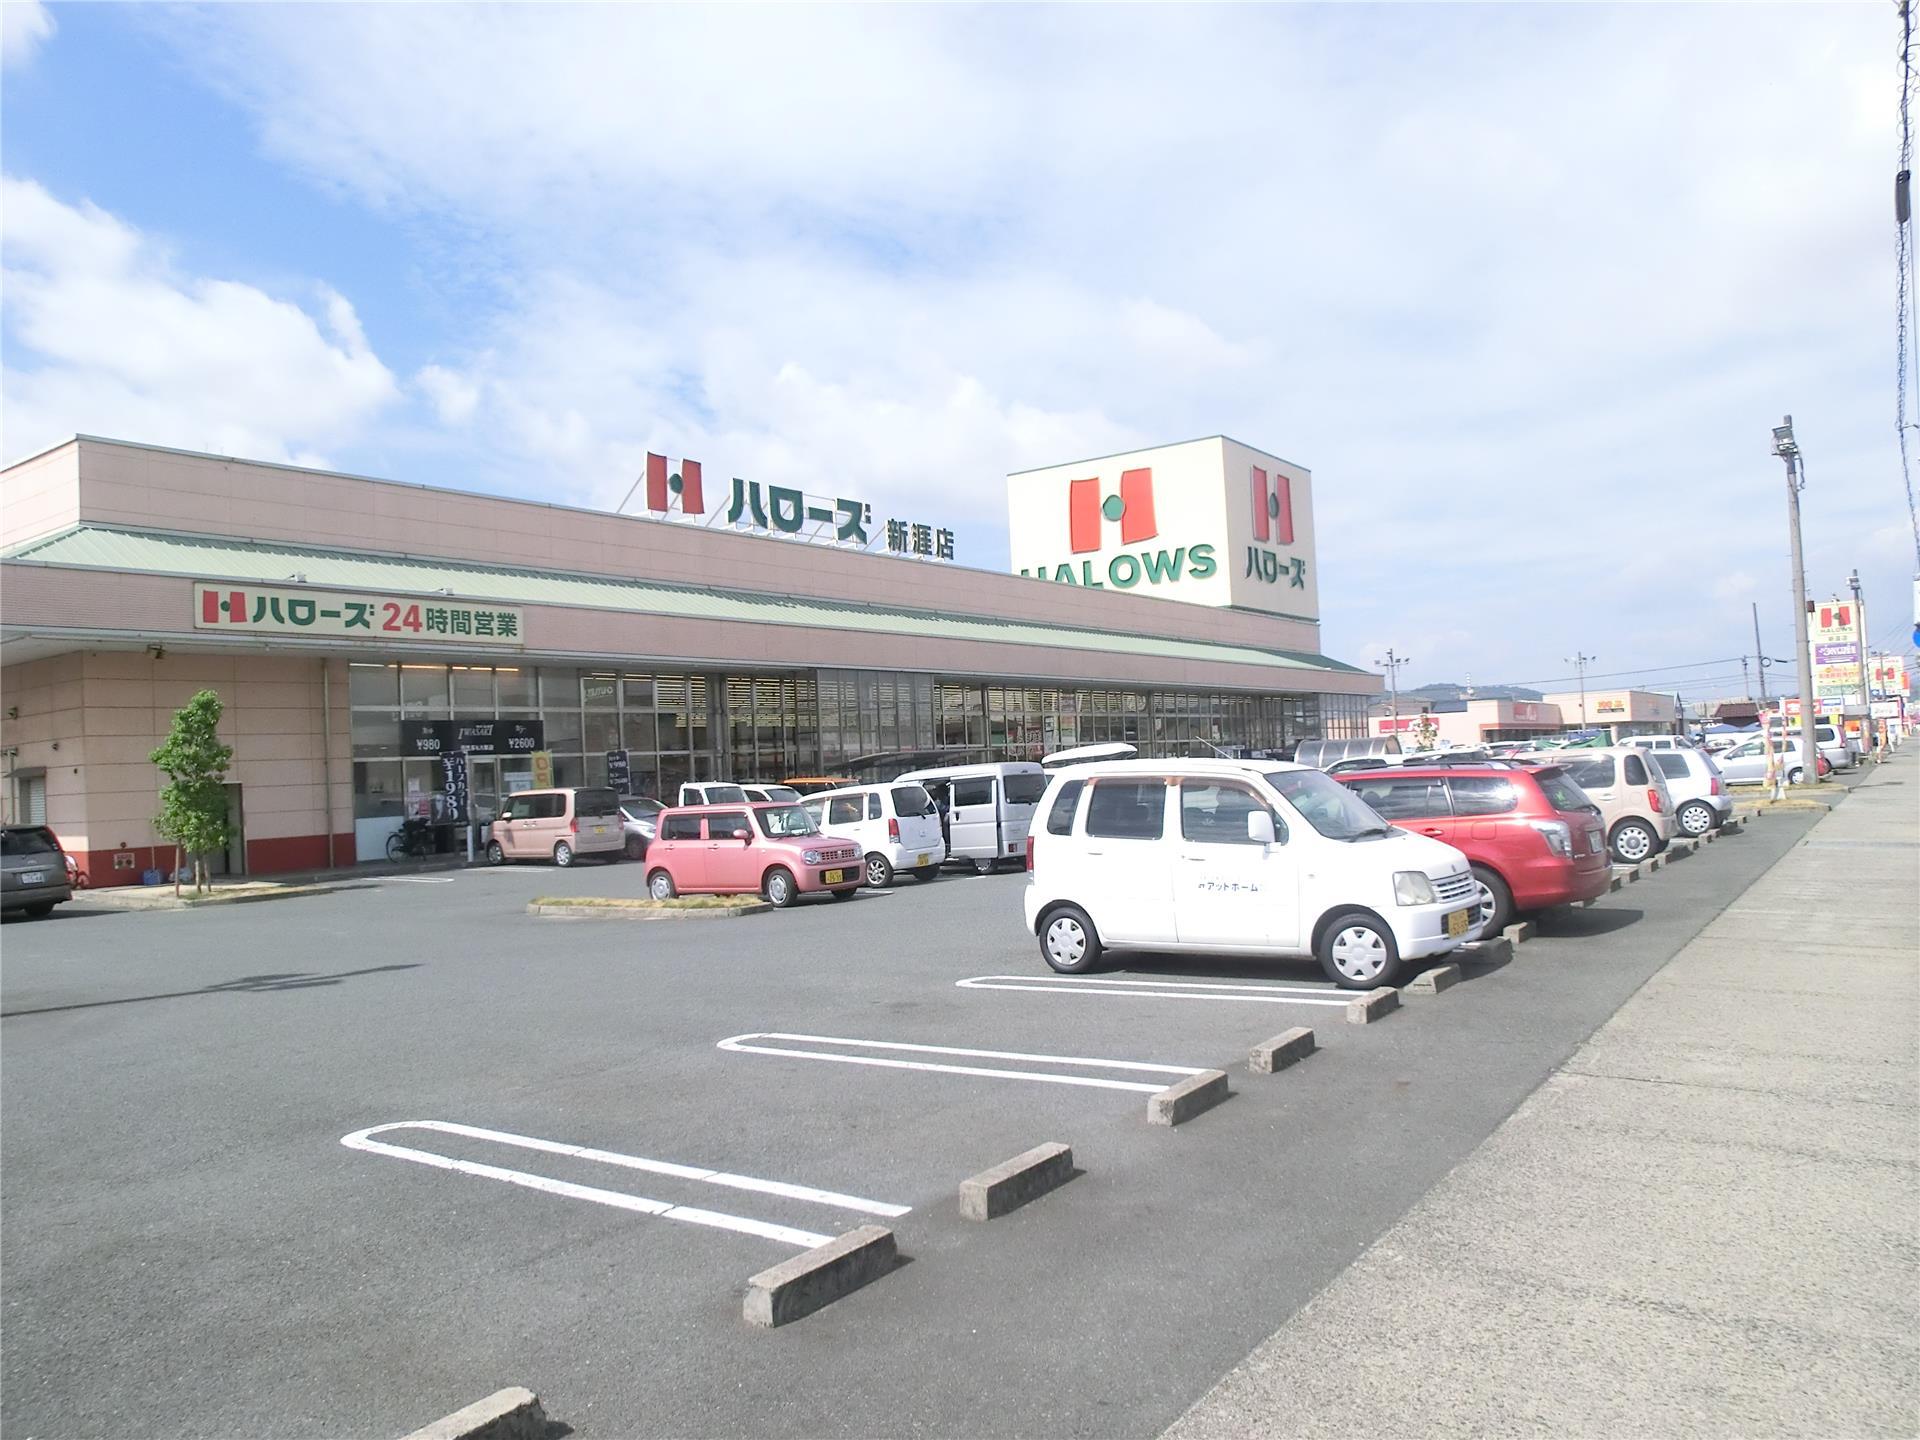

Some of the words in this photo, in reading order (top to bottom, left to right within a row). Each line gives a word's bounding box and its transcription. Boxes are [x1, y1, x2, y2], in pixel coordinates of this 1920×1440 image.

[728, 477, 872, 545] ハローズ
[886, 518, 954, 560] 新涯店
[1245, 546, 1306, 591] ハローズ
[252, 596, 376, 630] ハローズ
[458, 724, 494, 740] IWASAKI
[508, 737, 536, 749] ¥2600
[416, 739, 441, 751] ¥980
[442, 757, 459, 820] ¥1980
[1207, 882, 1258, 892] アットホーム
